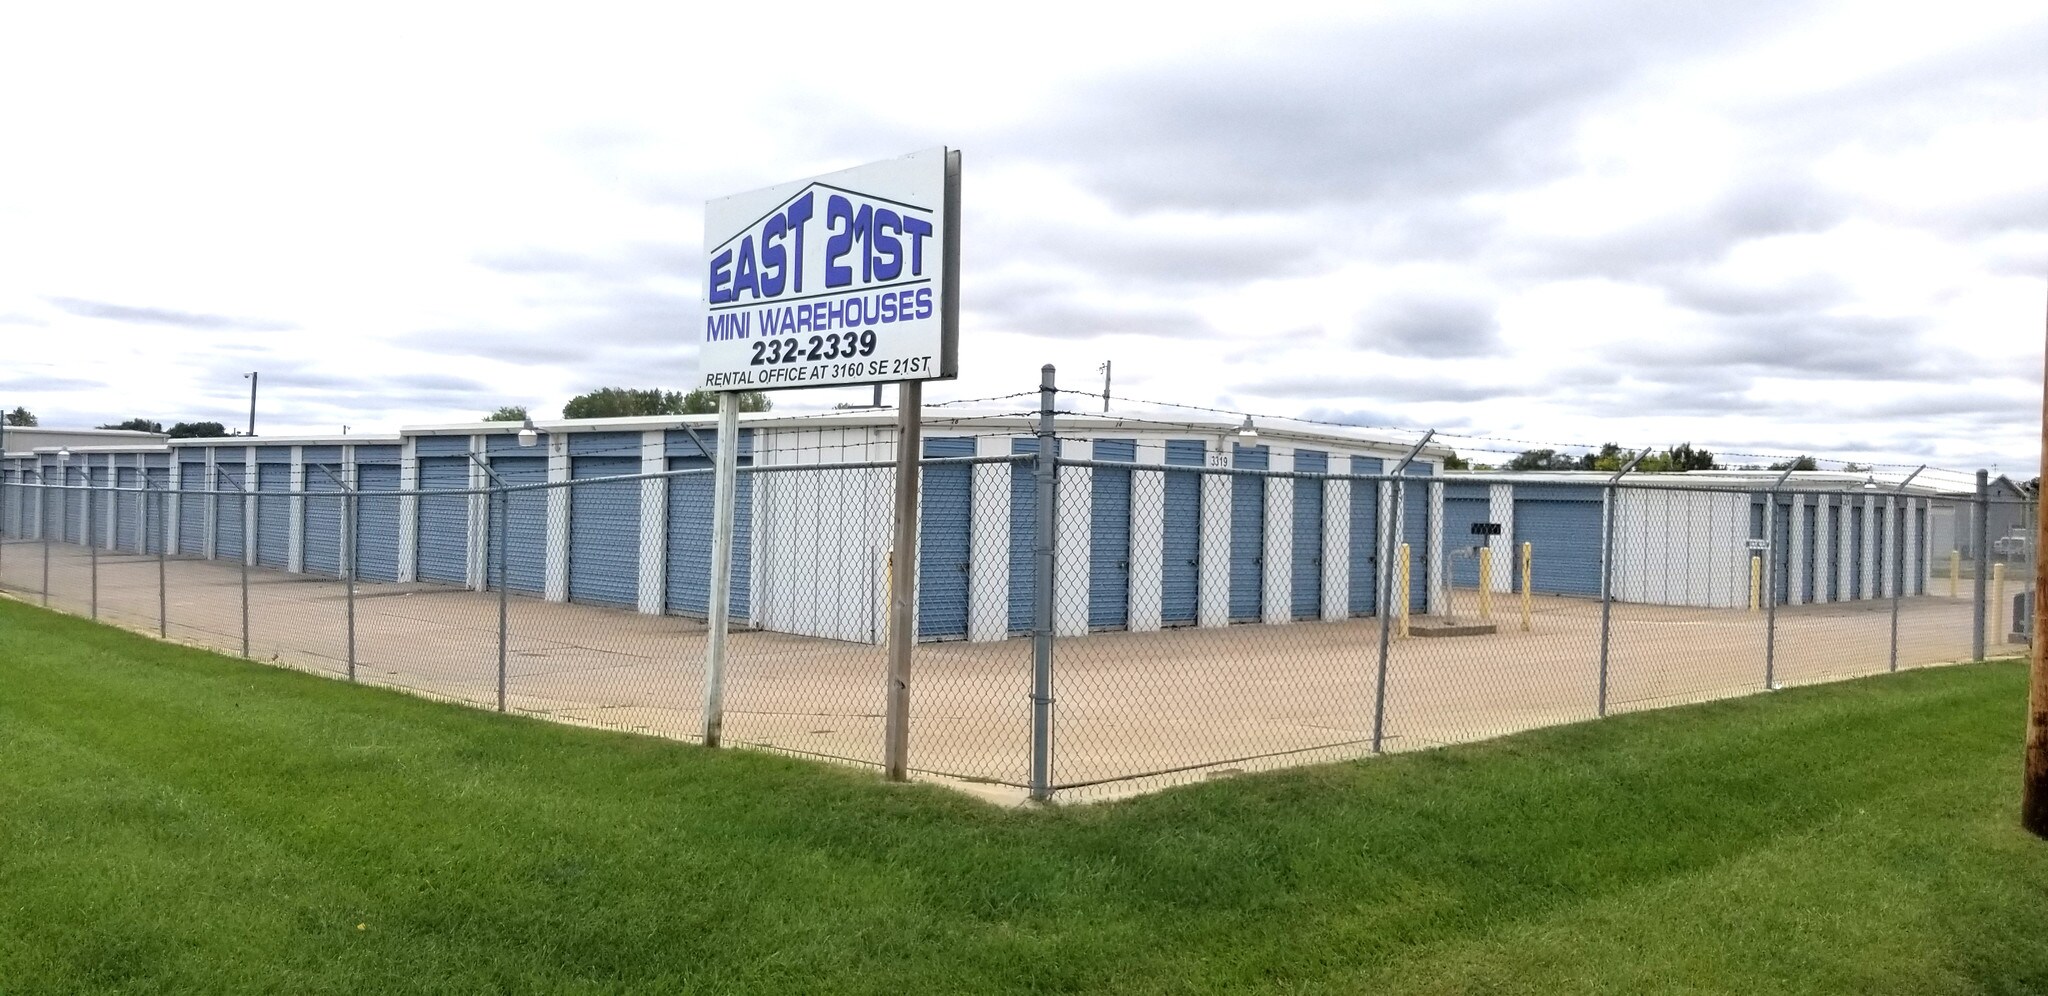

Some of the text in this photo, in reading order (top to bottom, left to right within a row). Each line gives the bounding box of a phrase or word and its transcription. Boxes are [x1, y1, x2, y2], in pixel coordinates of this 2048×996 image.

[709, 190, 933, 304] EAST 21ST
[706, 287, 933, 342] MINI WAREHOUSES
[750, 329, 877, 366] 232-2339
[705, 356, 931, 387] RENTAL OFFICE AT 3160 SE 21ST
[1210, 455, 1228, 467] 3319
